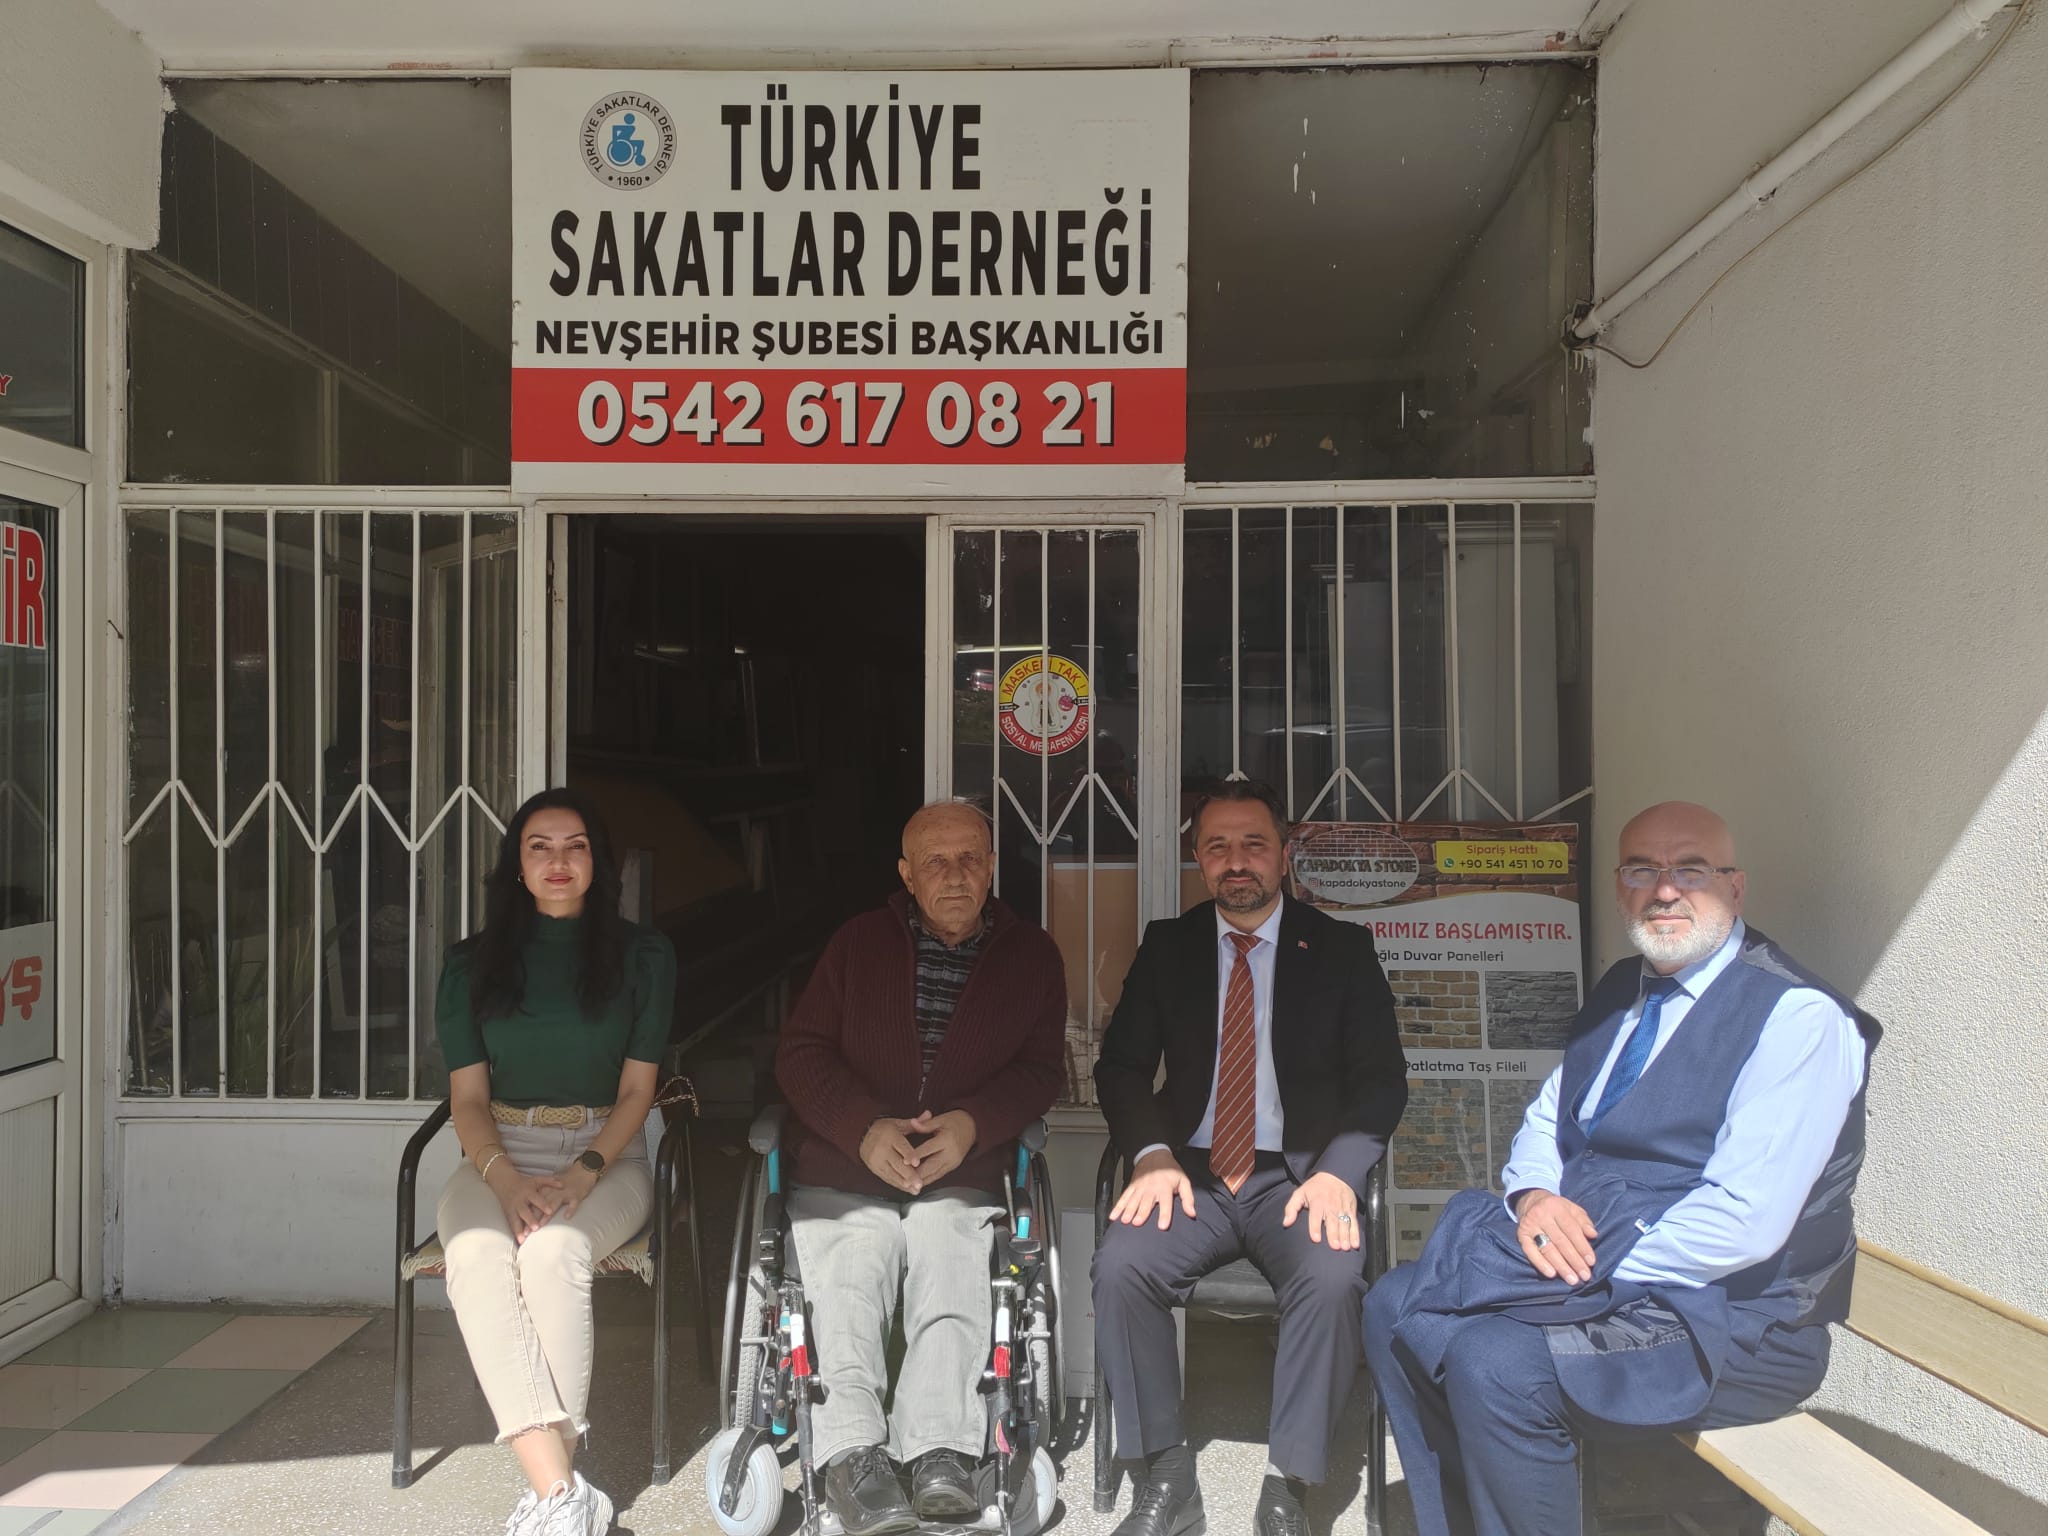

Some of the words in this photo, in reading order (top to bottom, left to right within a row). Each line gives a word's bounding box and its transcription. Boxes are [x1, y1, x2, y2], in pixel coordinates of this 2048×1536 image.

[583, 118, 604, 173] TÜRKİYE
[596, 96, 660, 118] SAKATLAR
[654, 116, 673, 174] DERNEĞİ
[721, 84, 980, 191] TÜRKİYE
[616, 176, 643, 186] 1960
[550, 210, 864, 296] SAKATLAR
[888, 187, 1151, 296] DERNEĞİ
[537, 314, 739, 361] NEVŞEHİR
[752, 314, 896, 361] ŞUBESİ
[912, 312, 1162, 361] BAŞKANLIĞI
[578, 381, 761, 443] 0542
[787, 381, 902, 444] 617
[927, 382, 1018, 444] 08
[1043, 381, 1111, 443] 21
[1058, 661, 1081, 683] TAK
[1001, 715, 1027, 747] SOSYAL
[1029, 730, 1076, 751] MEAFENİ
[1466, 844, 1506, 856] Sipariş
[1509, 845, 1538, 855] Hattı
[1374, 859, 1417, 873] STONE
[1459, 859, 1482, 869] +90
[1486, 859, 1505, 869] 541
[1508, 859, 1528, 869] 451
[1532, 860, 1545, 869] 10
[1548, 860, 1563, 869] 70
[1319, 878, 1407, 889] kapadokyastone
[1435, 922, 1572, 943] BAŞLAMIŞTIR.
[1378, 950, 1399, 963] ğla
[1403, 950, 1443, 961] Duvar
[1447, 950, 1504, 962] Panelleri
[1468, 1061, 1492, 1074] Taş
[1496, 1061, 1527, 1073] Fileli
